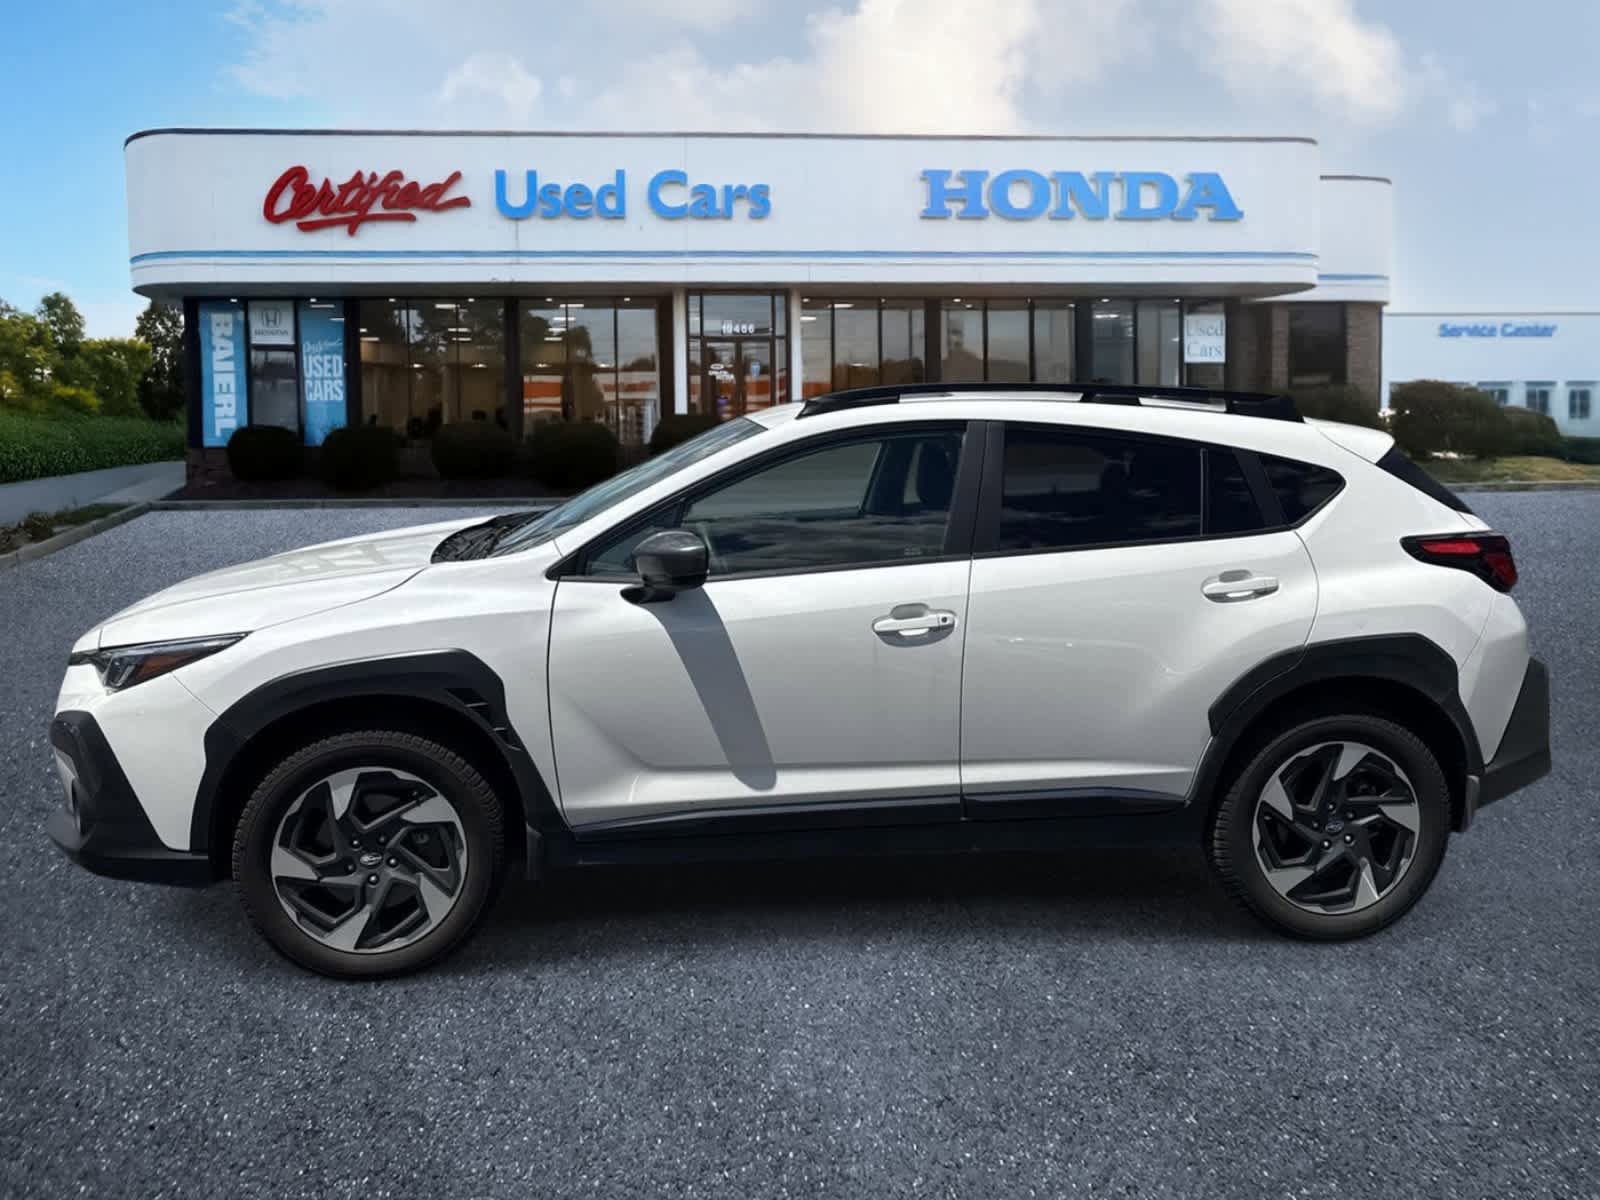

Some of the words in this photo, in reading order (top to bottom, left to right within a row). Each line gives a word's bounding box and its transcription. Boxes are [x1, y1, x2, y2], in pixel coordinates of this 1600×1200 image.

[264, 165, 471, 237] Certified
[494, 168, 627, 220] Used
[647, 168, 772, 221] Cars
[919, 168, 1245, 222] HONDA
[1438, 323, 1497, 338] Service
[1501, 322, 1557, 338] Center
[1186, 341, 1224, 357] Cars
[210, 312, 237, 437] BAIERL
[303, 354, 343, 378] USED
[304, 379, 345, 402] CARS
